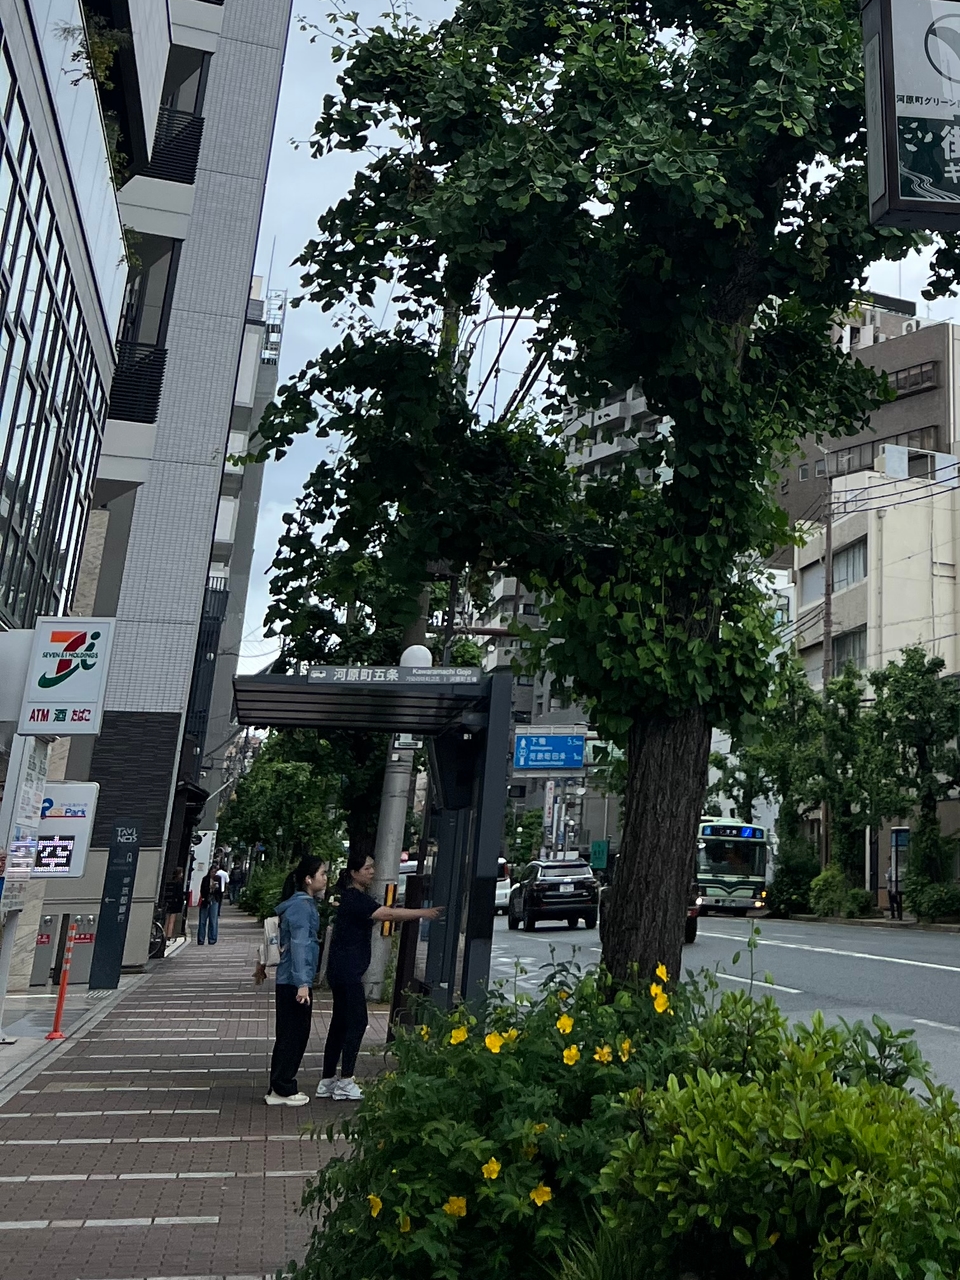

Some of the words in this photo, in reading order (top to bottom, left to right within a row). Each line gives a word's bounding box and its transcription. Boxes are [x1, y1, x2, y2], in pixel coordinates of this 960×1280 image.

[333, 668, 399, 682] 河原町五条
[29, 708, 50, 722] ATM
[53, 708, 68, 722] 酒
[70, 708, 91, 722] たばこ
[64, 808, 86, 816] Park
